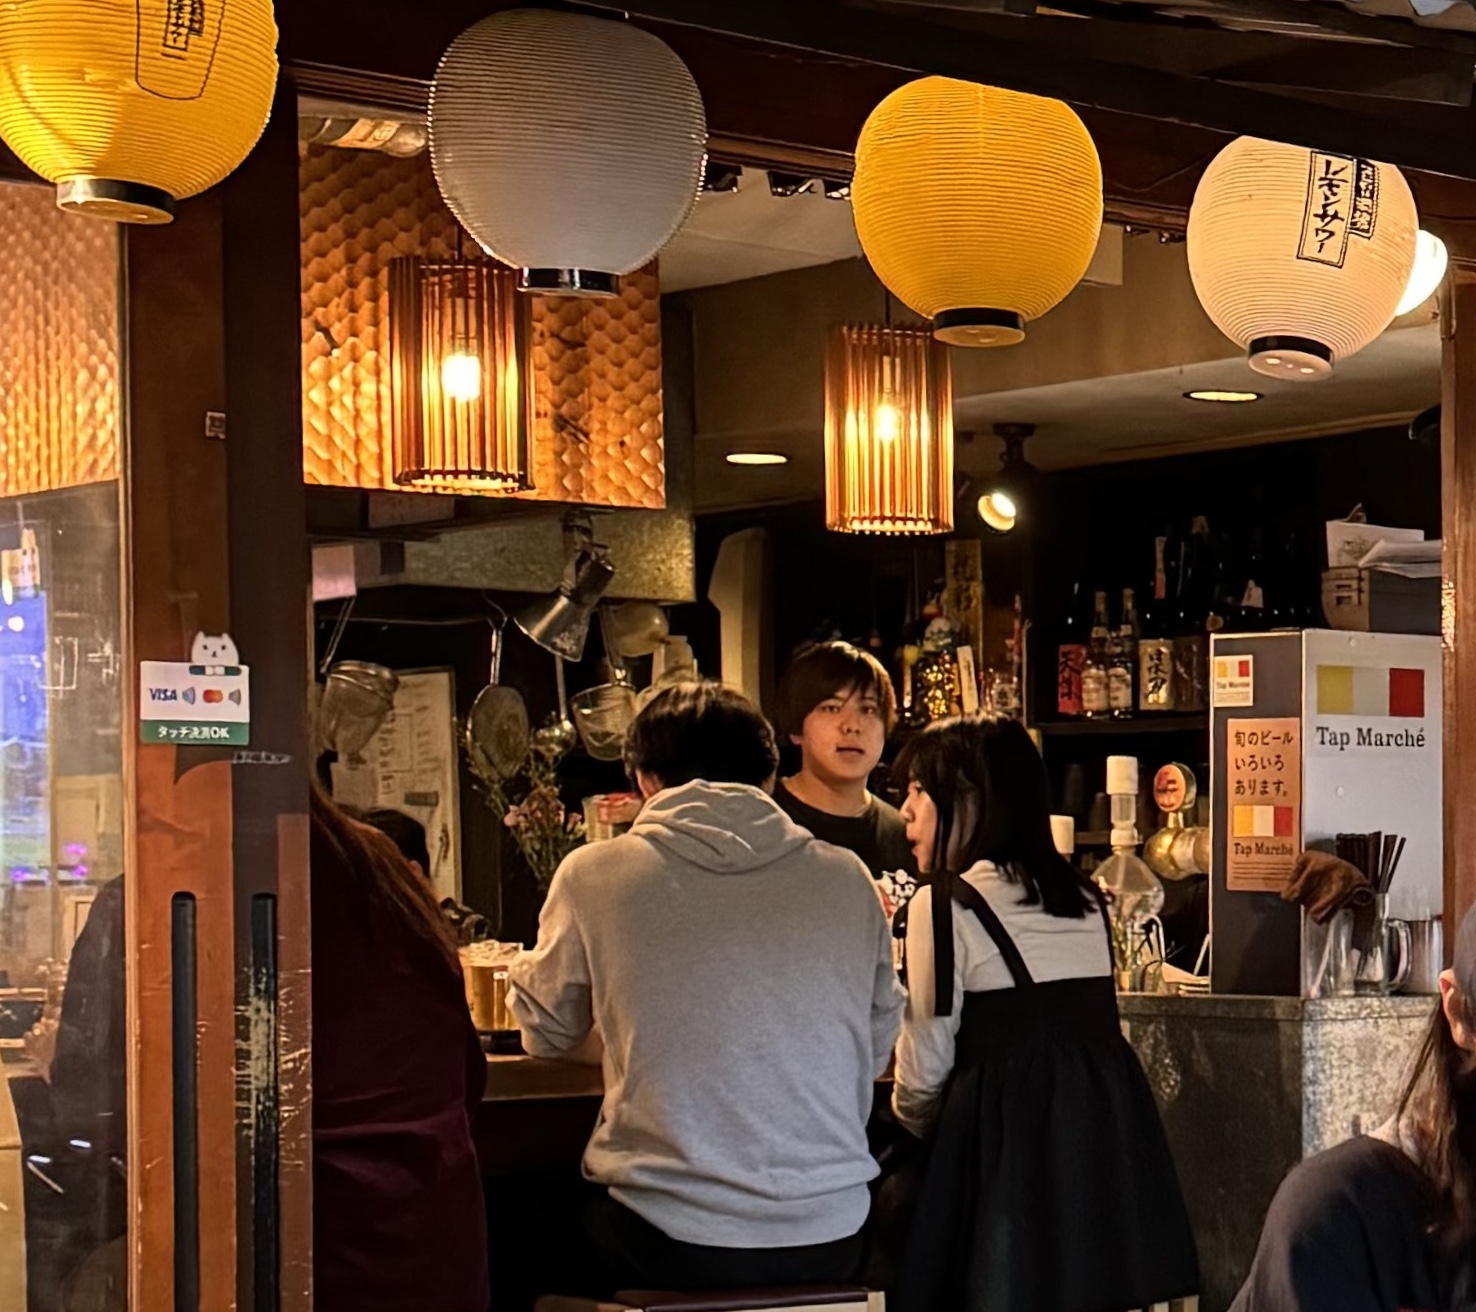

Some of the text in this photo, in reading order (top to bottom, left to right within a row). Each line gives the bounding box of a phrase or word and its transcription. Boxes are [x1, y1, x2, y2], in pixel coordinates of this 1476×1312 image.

[1312, 158, 1349, 254] レモンサワー
[149, 688, 177, 700] VISA
[1234, 731, 1293, 748] 旬のビール
[1316, 726, 1425, 751] Tap Marché
[1235, 754, 1285, 771] いろいろ
[1235, 779, 1288, 796] あります。
[1234, 843, 1252, 857] Tap
